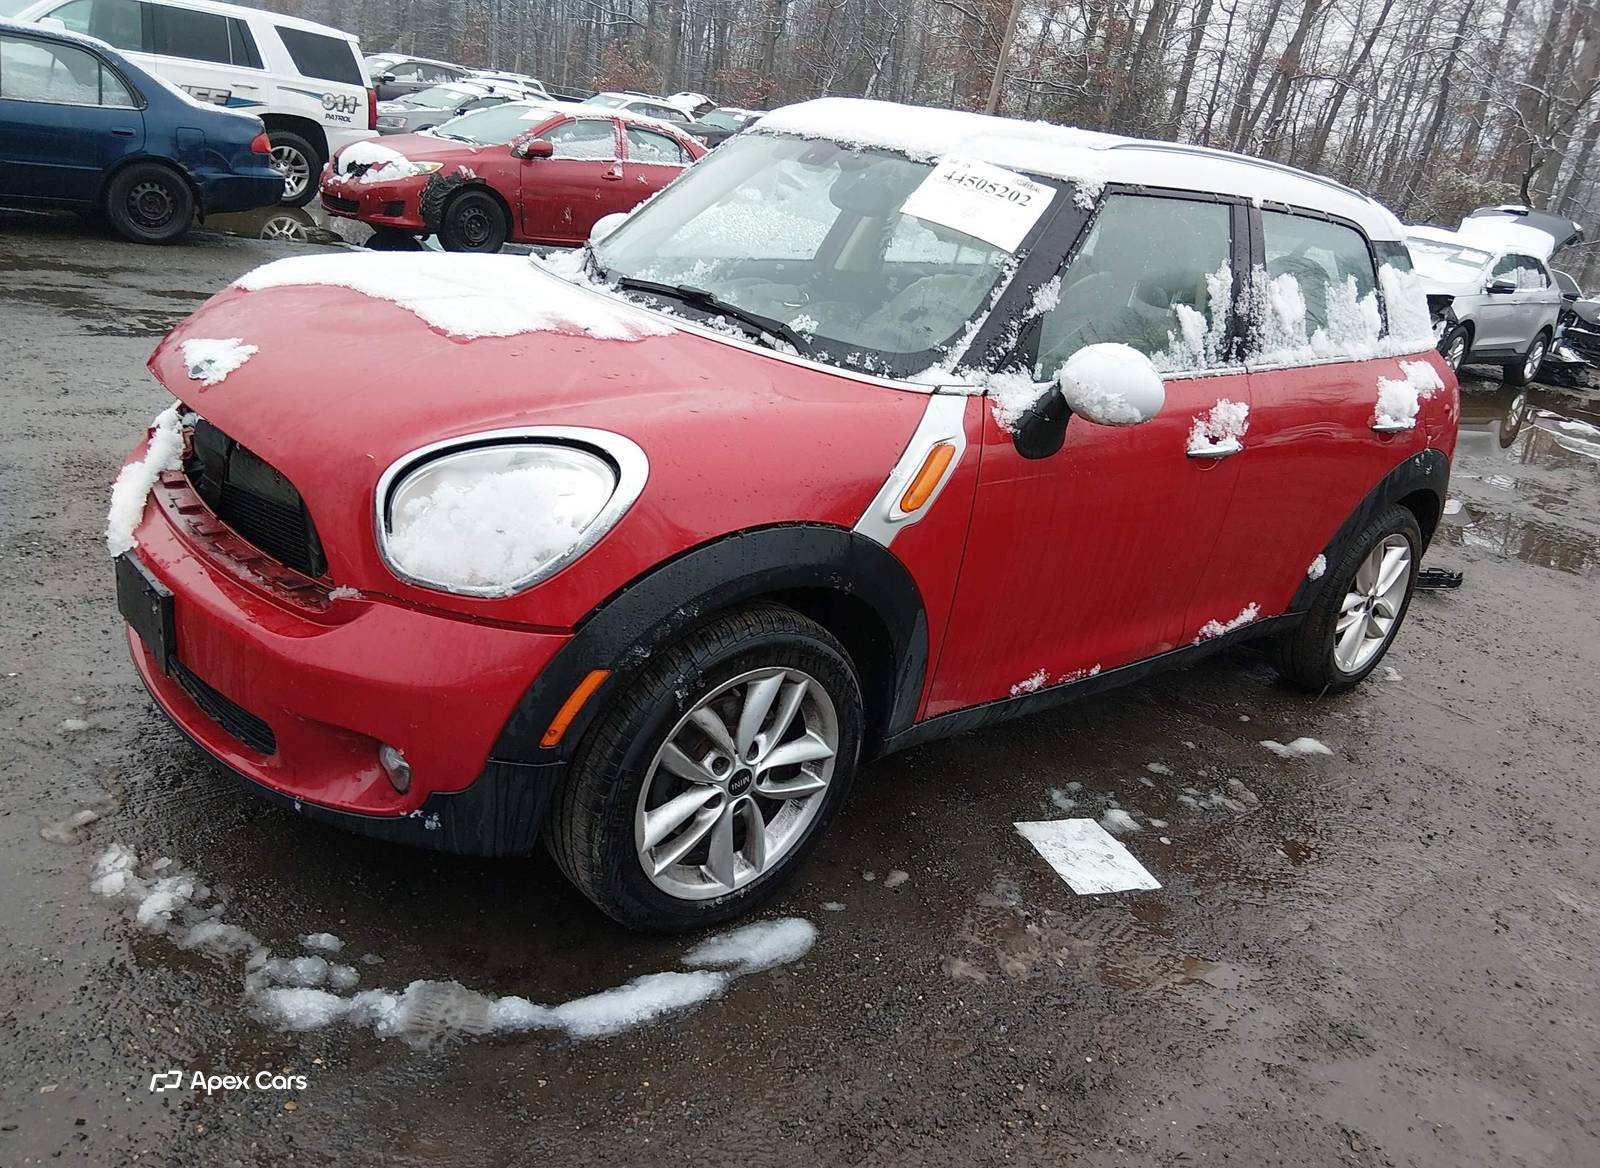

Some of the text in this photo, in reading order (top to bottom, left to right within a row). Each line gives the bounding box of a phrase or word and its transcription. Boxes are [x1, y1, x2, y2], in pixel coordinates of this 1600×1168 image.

[321, 92, 358, 115] 911
[324, 113, 352, 123] PATROL
[943, 170, 1032, 207] 44505202
[731, 774, 751, 791] MINI
